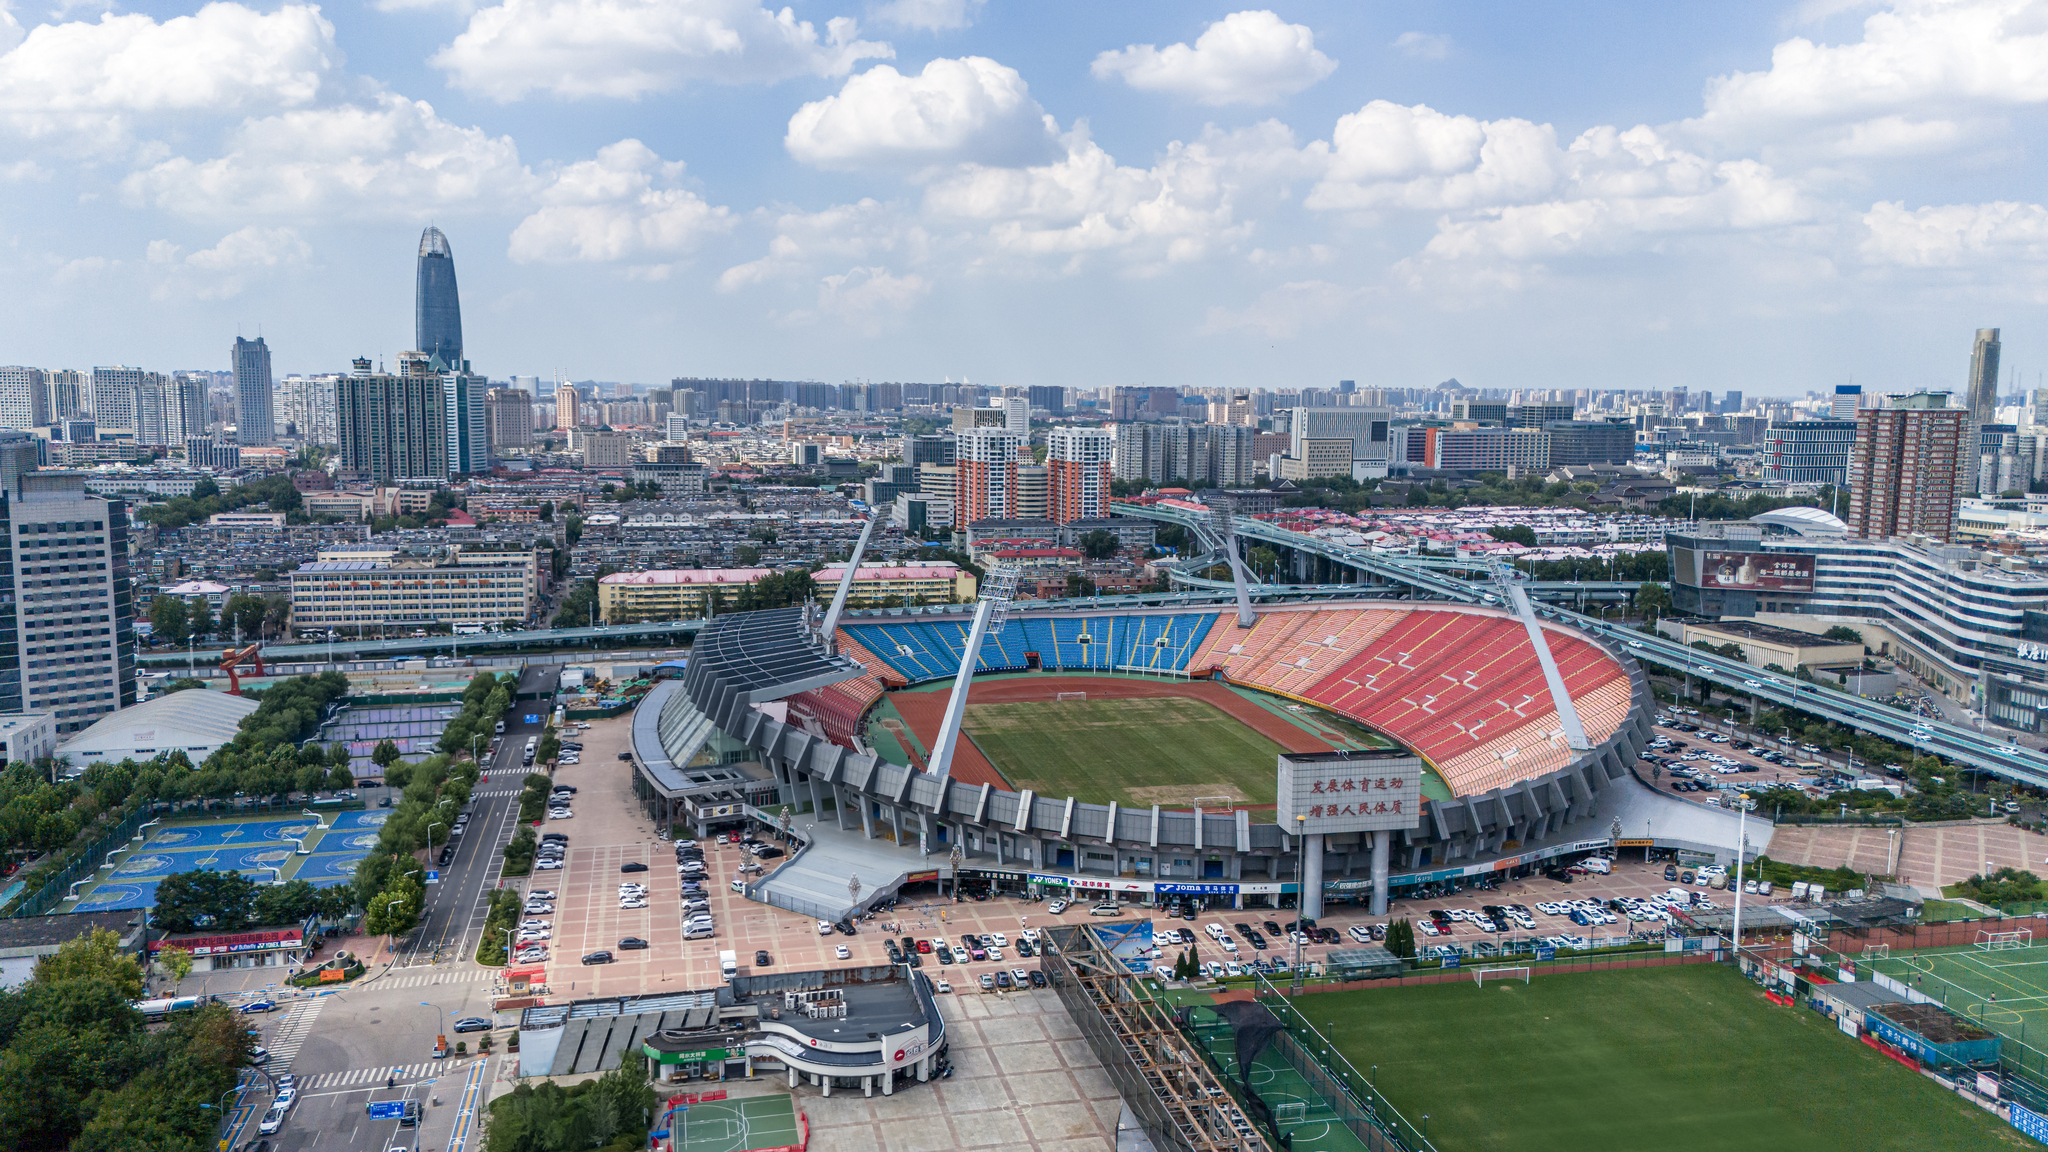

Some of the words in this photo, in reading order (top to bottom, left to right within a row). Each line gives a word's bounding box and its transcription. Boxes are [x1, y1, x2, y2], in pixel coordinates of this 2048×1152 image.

[1310, 777, 1403, 794] 发展体育运动
[1309, 799, 1403, 818] 增强人民体质
[1044, 877, 1063, 885] YONEX
